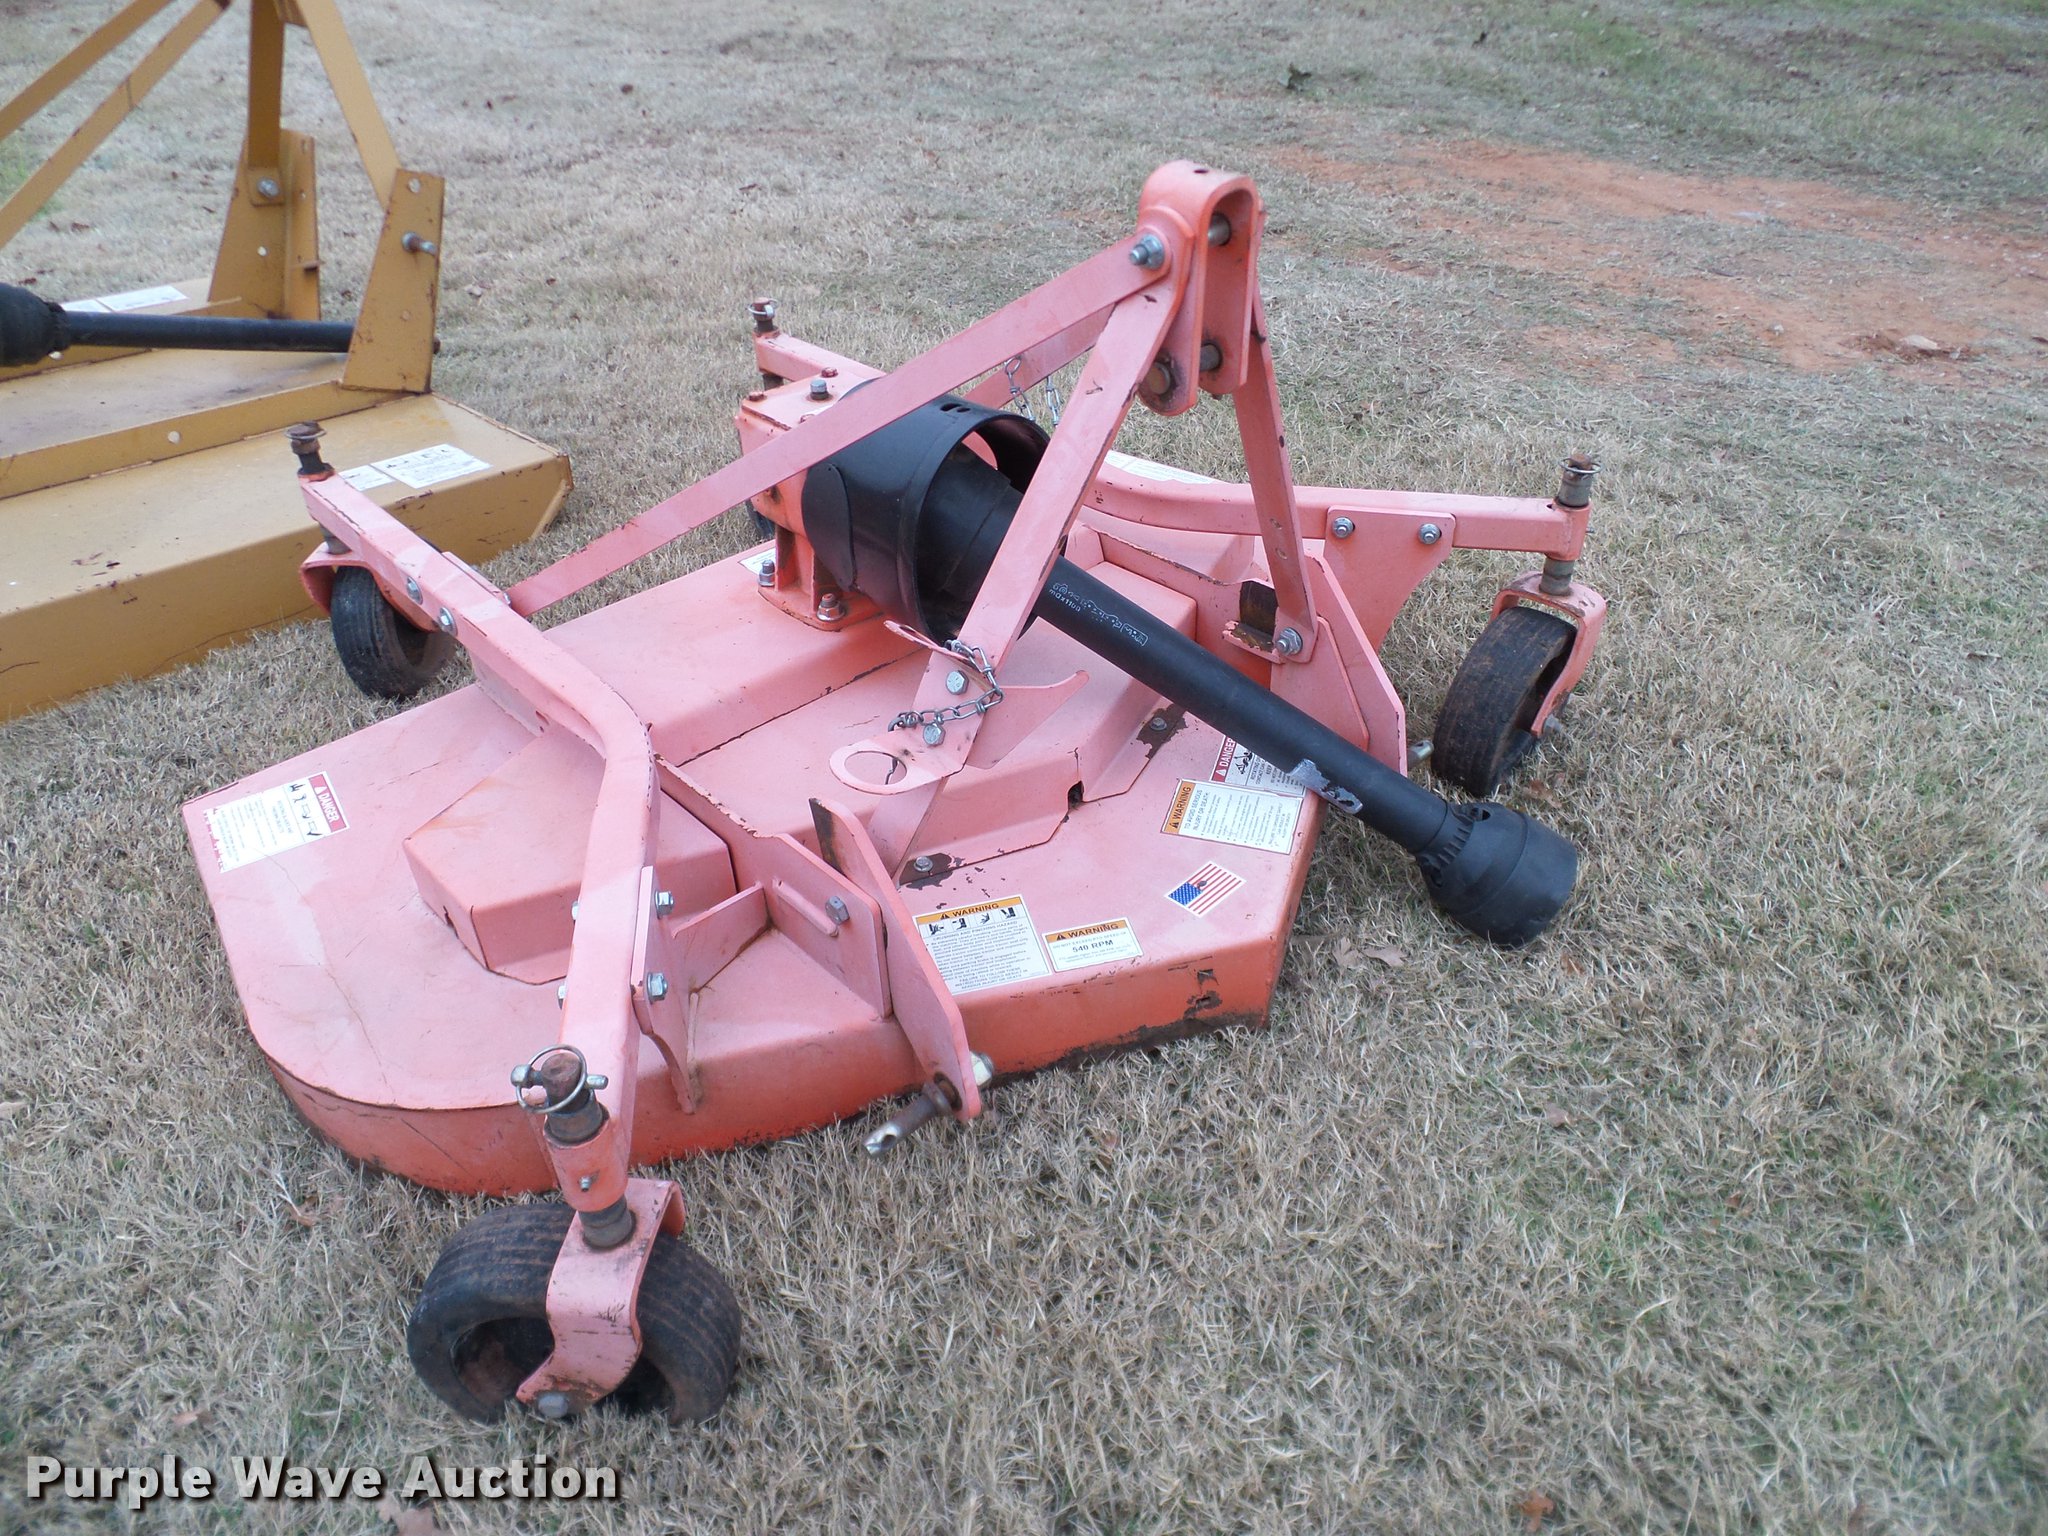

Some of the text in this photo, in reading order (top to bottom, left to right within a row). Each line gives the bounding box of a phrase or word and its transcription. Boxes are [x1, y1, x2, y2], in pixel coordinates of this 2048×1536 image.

[317, 792, 339, 822] DANGER
[1171, 785, 1191, 819] WARNING
[952, 902, 999, 917] WARNING
[1067, 922, 1118, 938] WARNING
[1072, 938, 1113, 953] 540 RPM
